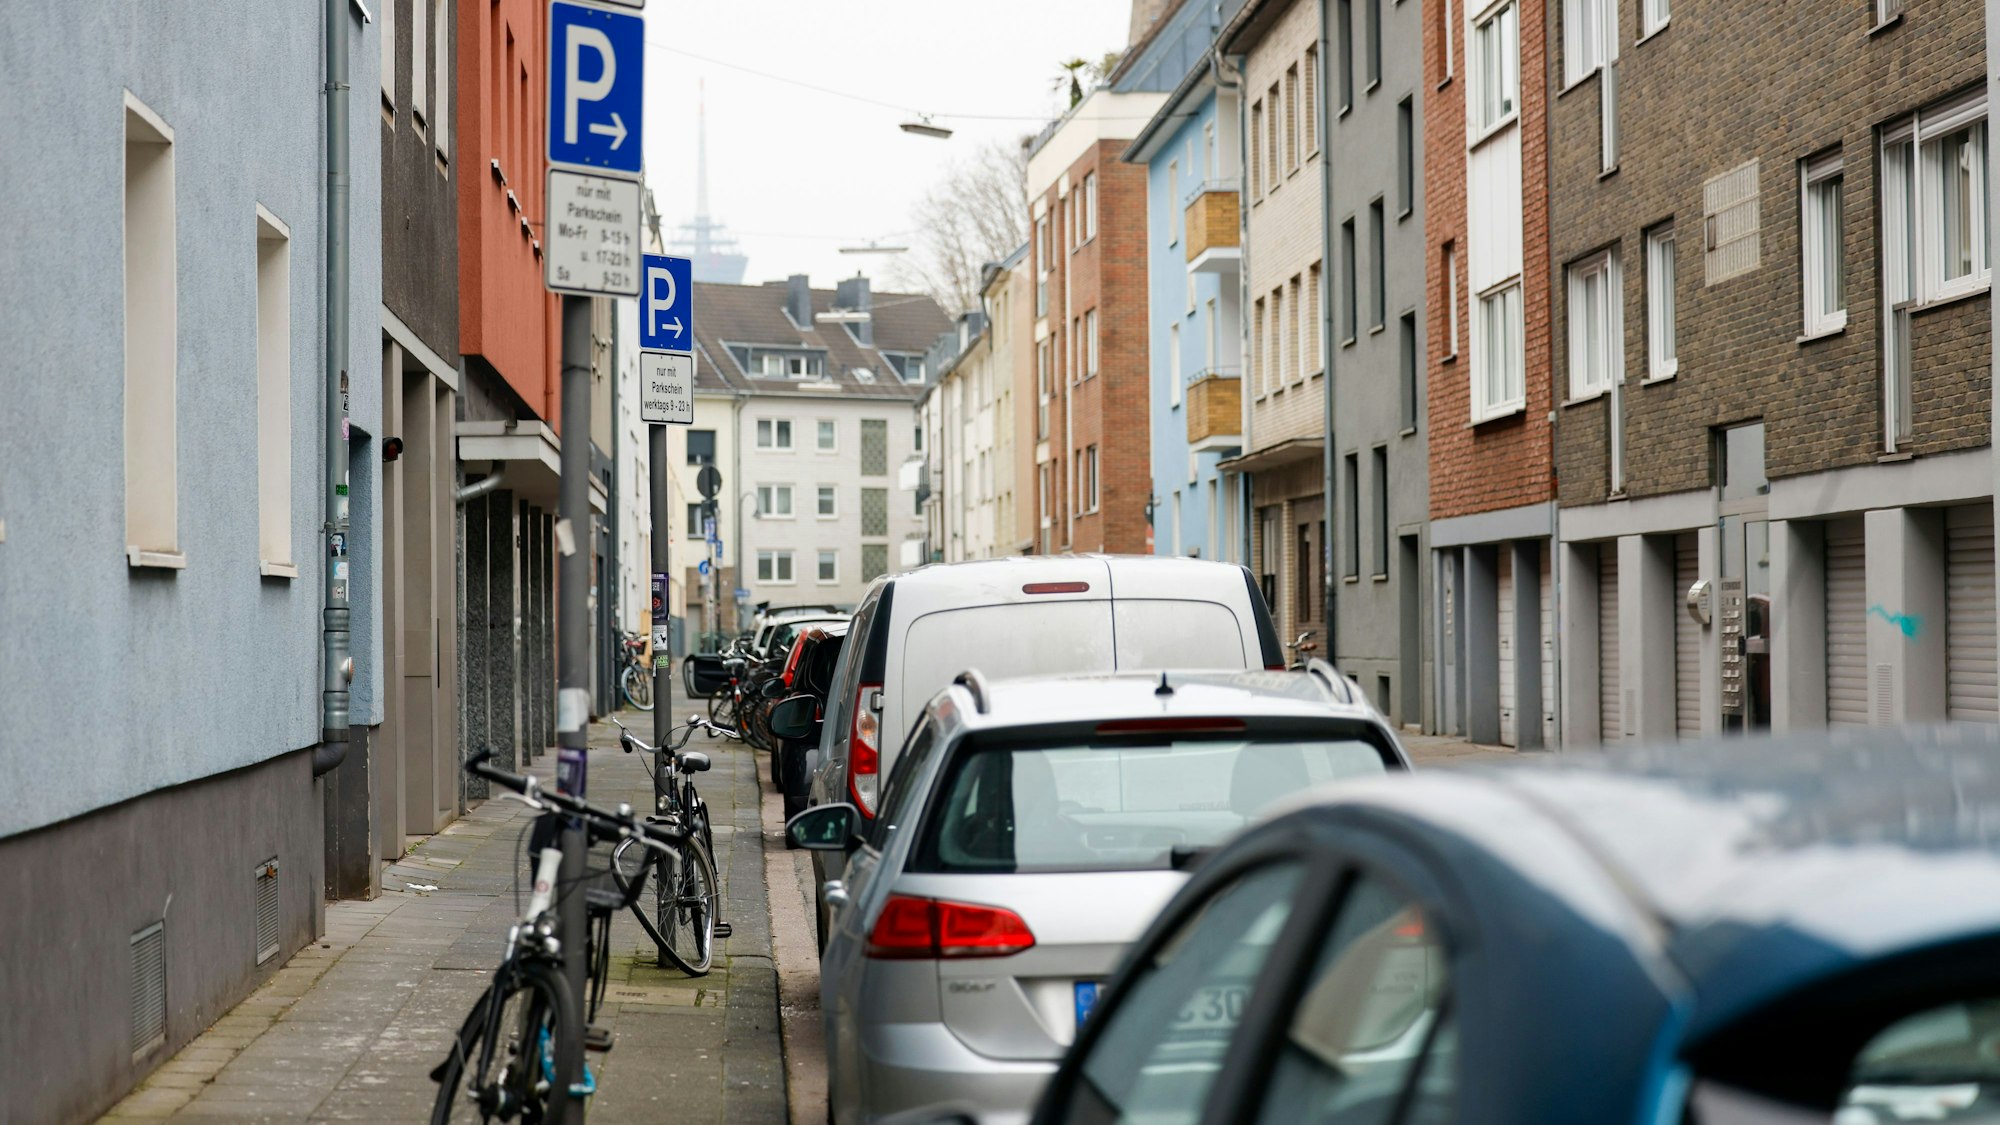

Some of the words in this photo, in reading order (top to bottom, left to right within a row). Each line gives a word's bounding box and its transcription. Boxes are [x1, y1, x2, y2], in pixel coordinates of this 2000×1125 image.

[564, 23, 617, 145] P
[576, 186, 593, 198] nur
[595, 187, 612, 201] mit
[567, 202, 622, 224] Parkschein
[558, 223, 587, 239] Mo-Fr
[596, 249, 622, 266] 17-23
[557, 265, 570, 281] Sa
[603, 271, 622, 286] 9-23
[647, 266, 676, 337] P
[656, 367, 666, 376] nur
[667, 366, 676, 378] mit
[652, 381, 682, 395] Parkschein
[644, 398, 669, 413] werktags
[670, 399, 675, 411] 9
[678, 400, 686, 412] 23
[686, 401, 690, 412] h
